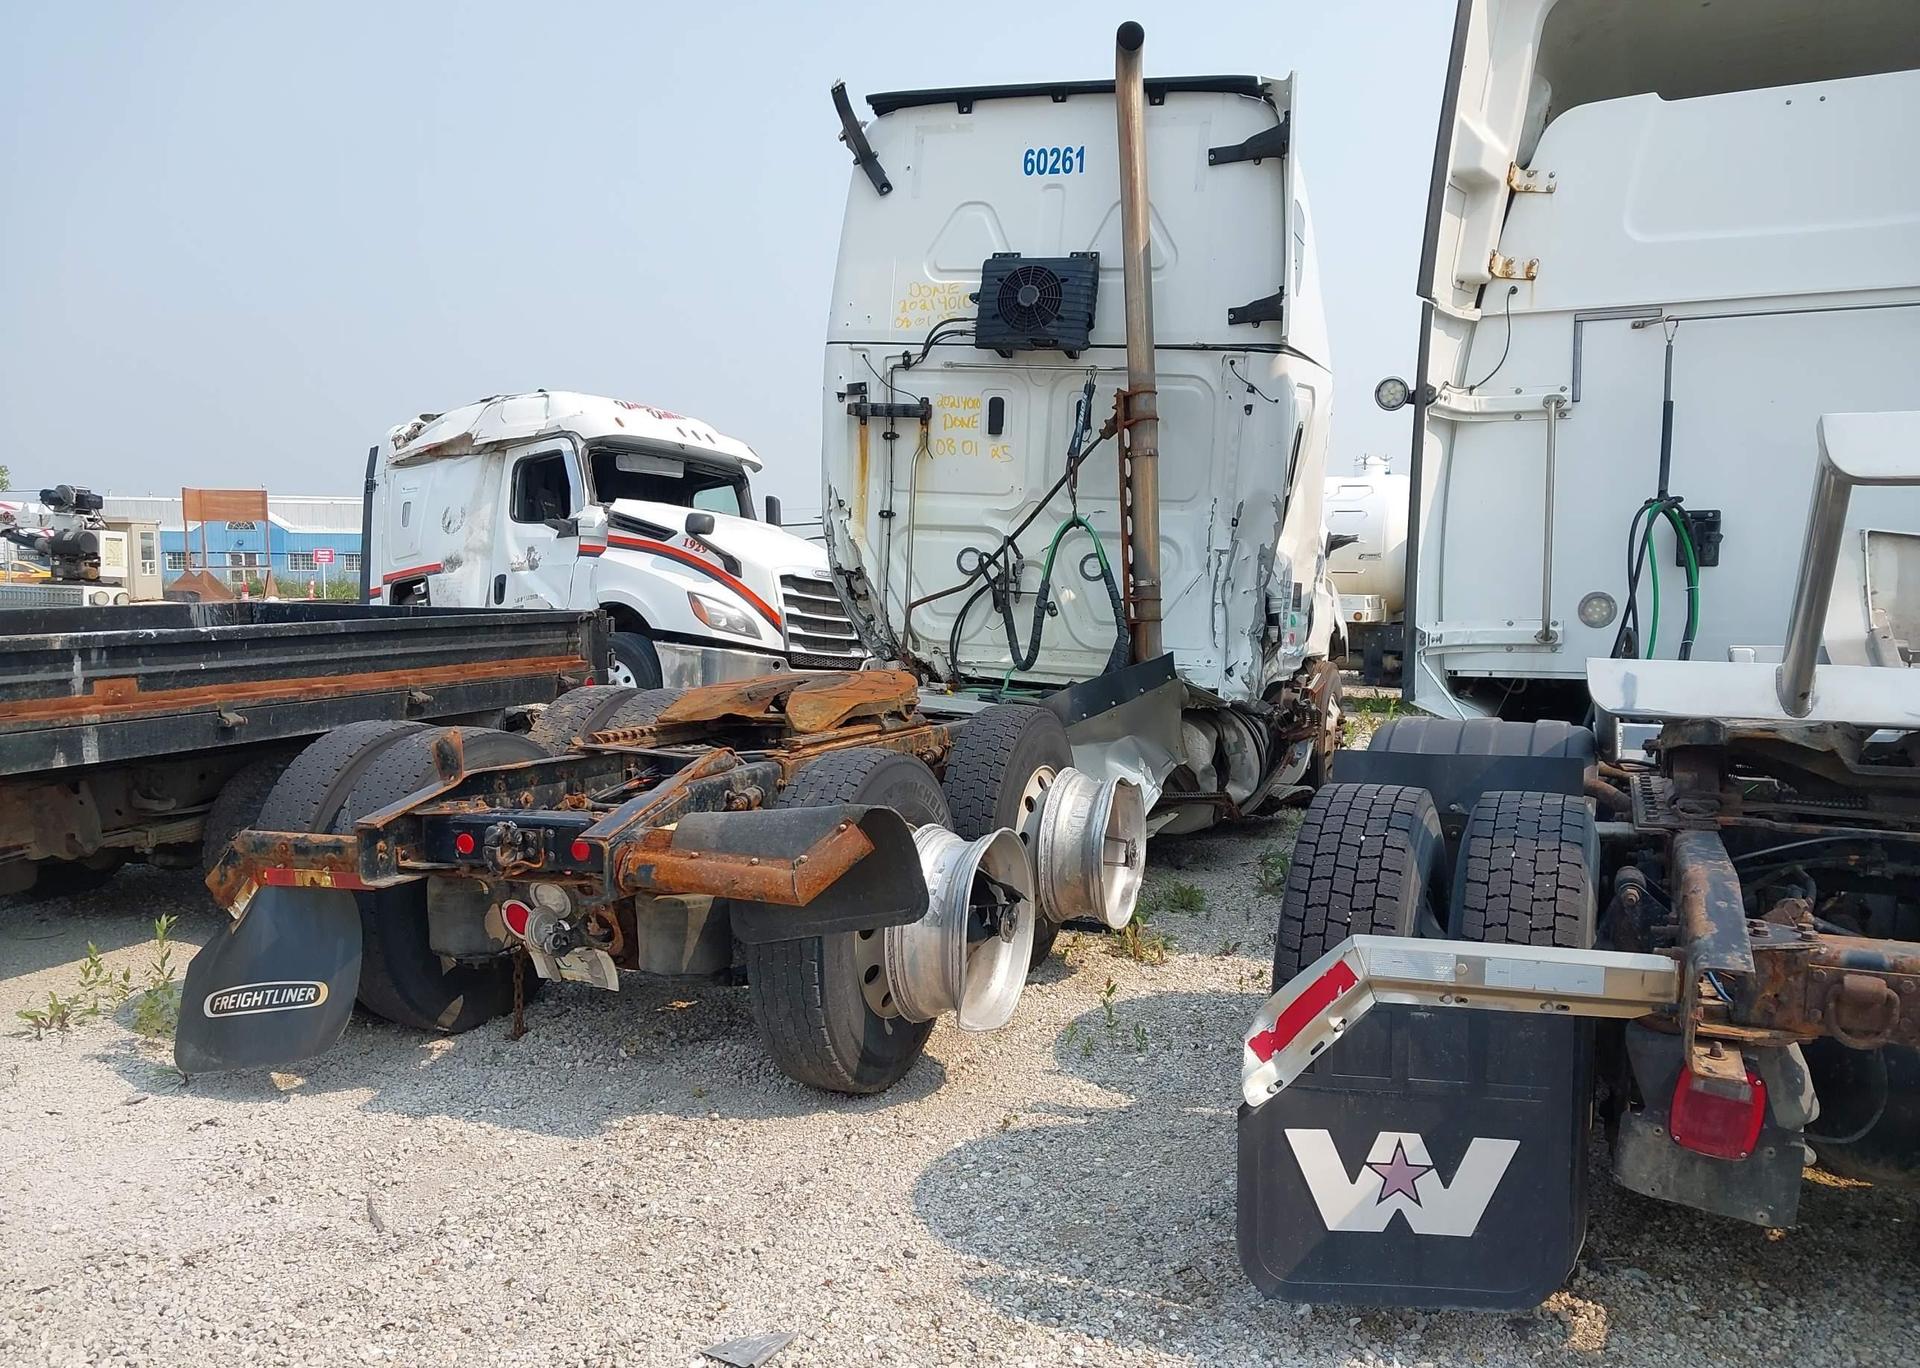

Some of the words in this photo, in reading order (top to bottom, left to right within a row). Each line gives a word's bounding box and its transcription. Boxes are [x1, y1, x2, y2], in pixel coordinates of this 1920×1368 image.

[1023, 145, 1085, 176] 60261
[909, 281, 960, 298] DONE
[943, 412, 980, 432] DONE
[936, 437, 956, 456] 08
[682, 537, 708, 553] 1929
[212, 986, 317, 1012] FREIGHTLINER
